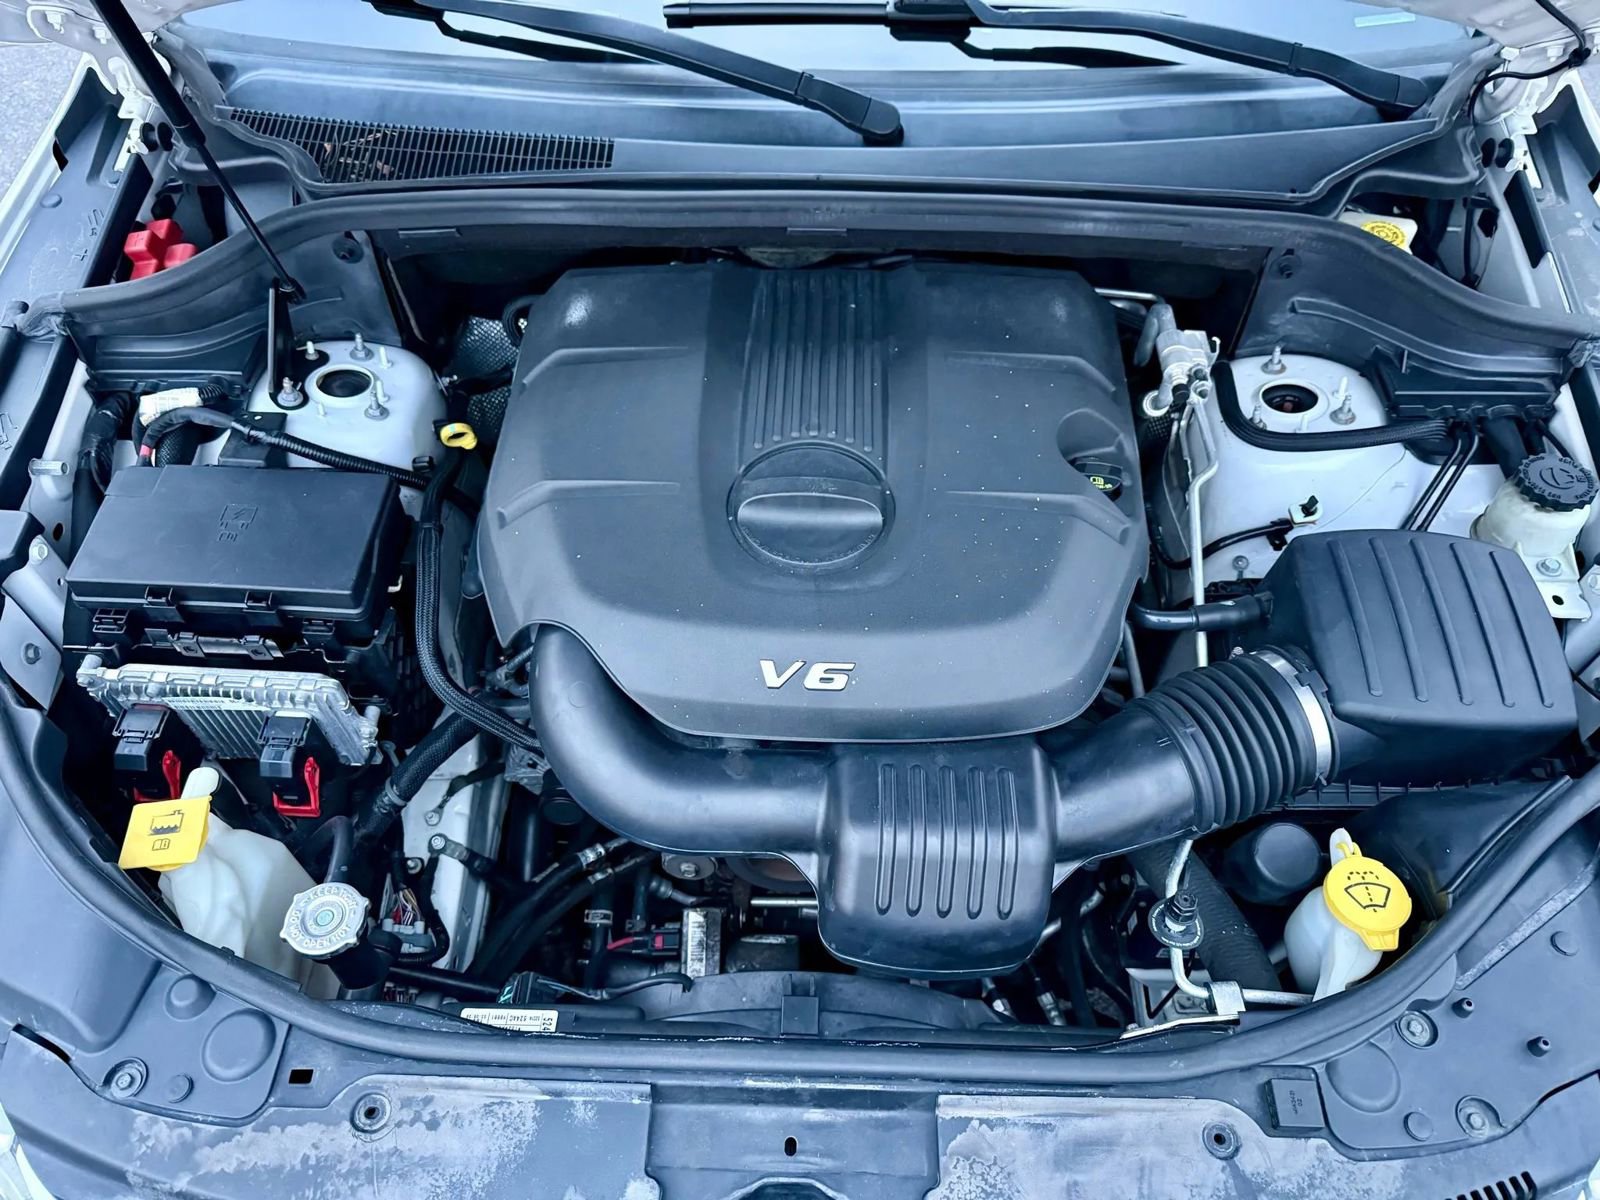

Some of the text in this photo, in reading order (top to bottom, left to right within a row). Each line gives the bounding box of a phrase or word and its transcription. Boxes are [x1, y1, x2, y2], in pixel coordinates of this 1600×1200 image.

[760, 659, 856, 691] V6
[309, 886, 340, 900] KEEP
[289, 908, 352, 948] DO NOT OPEN HOT
[542, 1017, 553, 1031] 524
